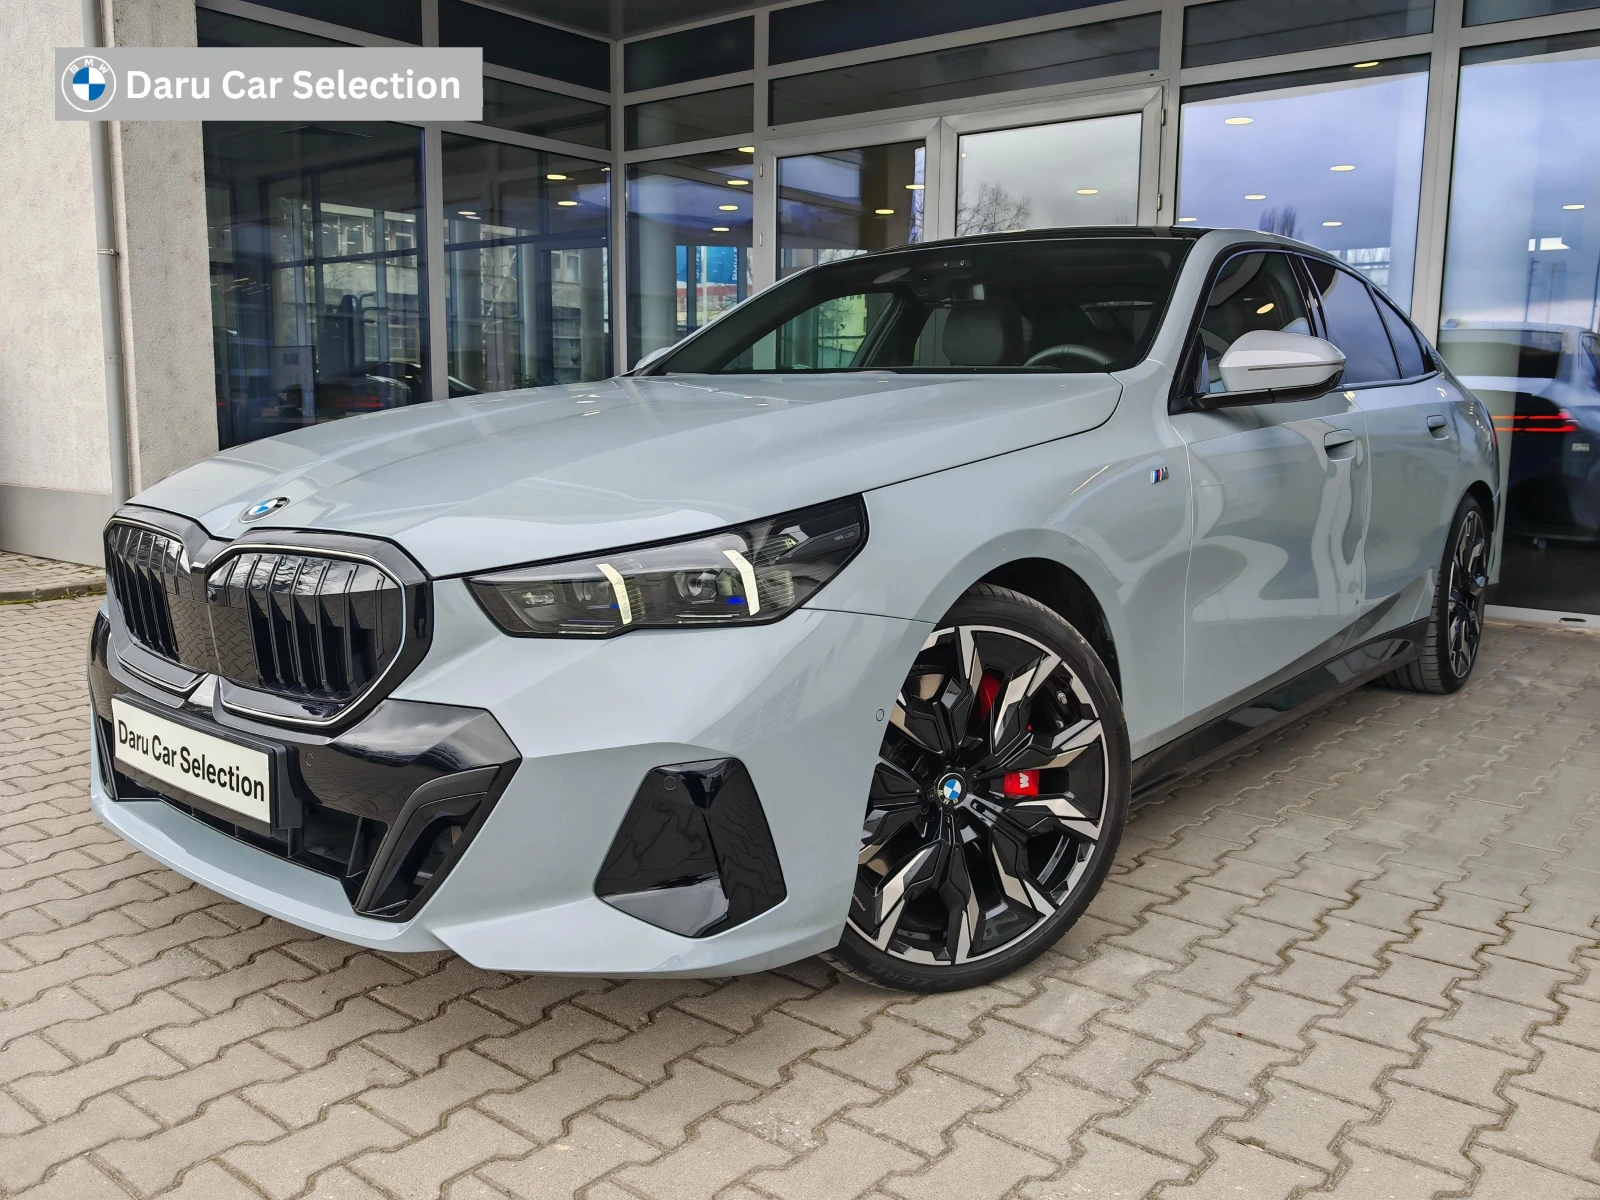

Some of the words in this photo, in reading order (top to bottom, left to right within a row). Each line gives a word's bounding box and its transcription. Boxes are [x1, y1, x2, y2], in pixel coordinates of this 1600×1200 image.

[117, 719, 149, 756] Daru
[151, 734, 177, 768] Car
[179, 746, 265, 802] Selection
[866, 962, 935, 988] ZERO
